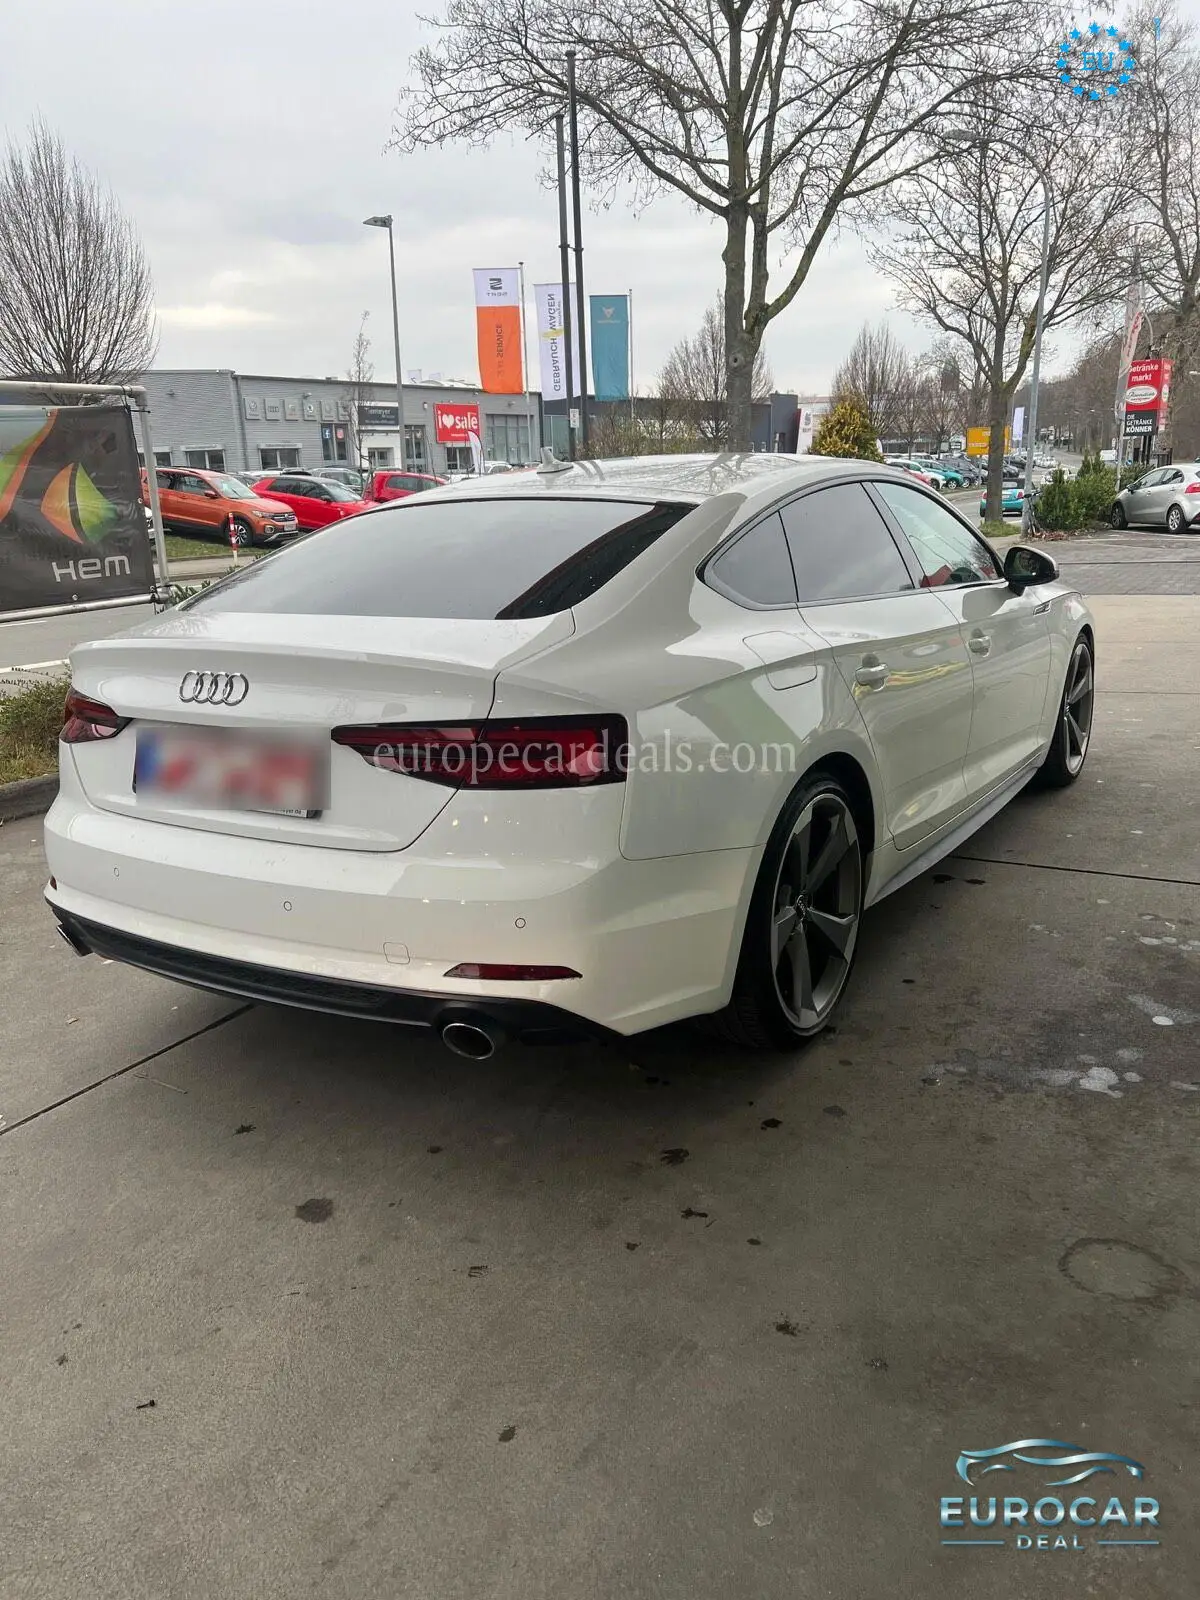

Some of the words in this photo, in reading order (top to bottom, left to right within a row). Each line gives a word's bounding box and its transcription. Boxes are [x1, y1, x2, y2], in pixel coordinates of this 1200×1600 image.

[1131, 373, 1152, 382] markt
[455, 412, 479, 430] sale
[1126, 425, 1153, 433] KÖNNER
